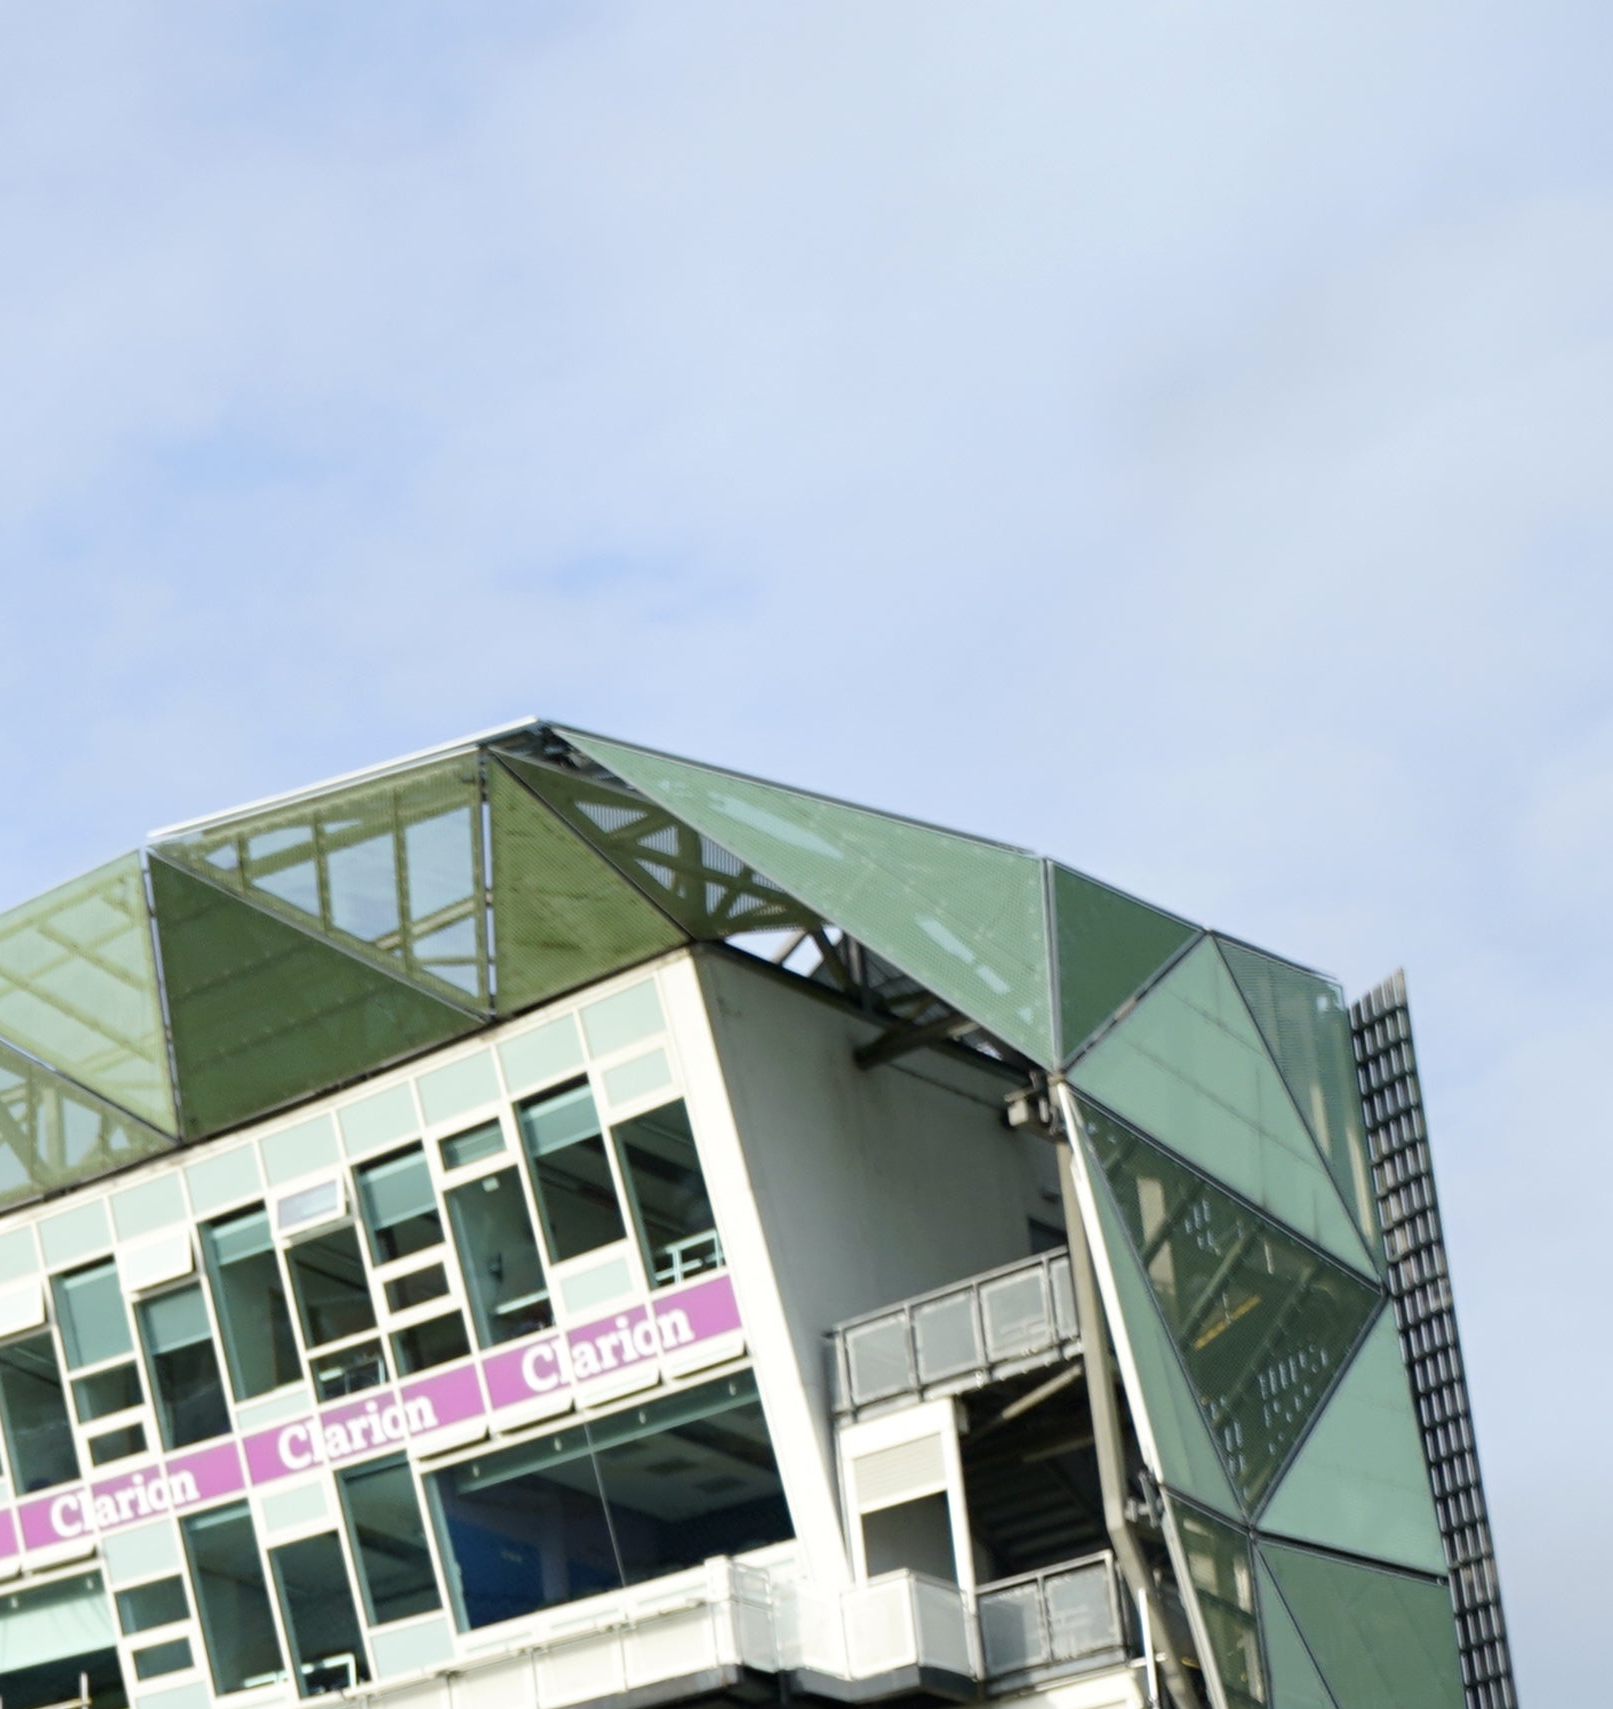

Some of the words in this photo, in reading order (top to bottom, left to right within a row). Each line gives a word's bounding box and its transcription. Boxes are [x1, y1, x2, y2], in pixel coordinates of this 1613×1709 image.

[521, 1308, 695, 1392] Clarion
[277, 1395, 438, 1470] Clarion
[50, 1469, 200, 1538] Clarion
